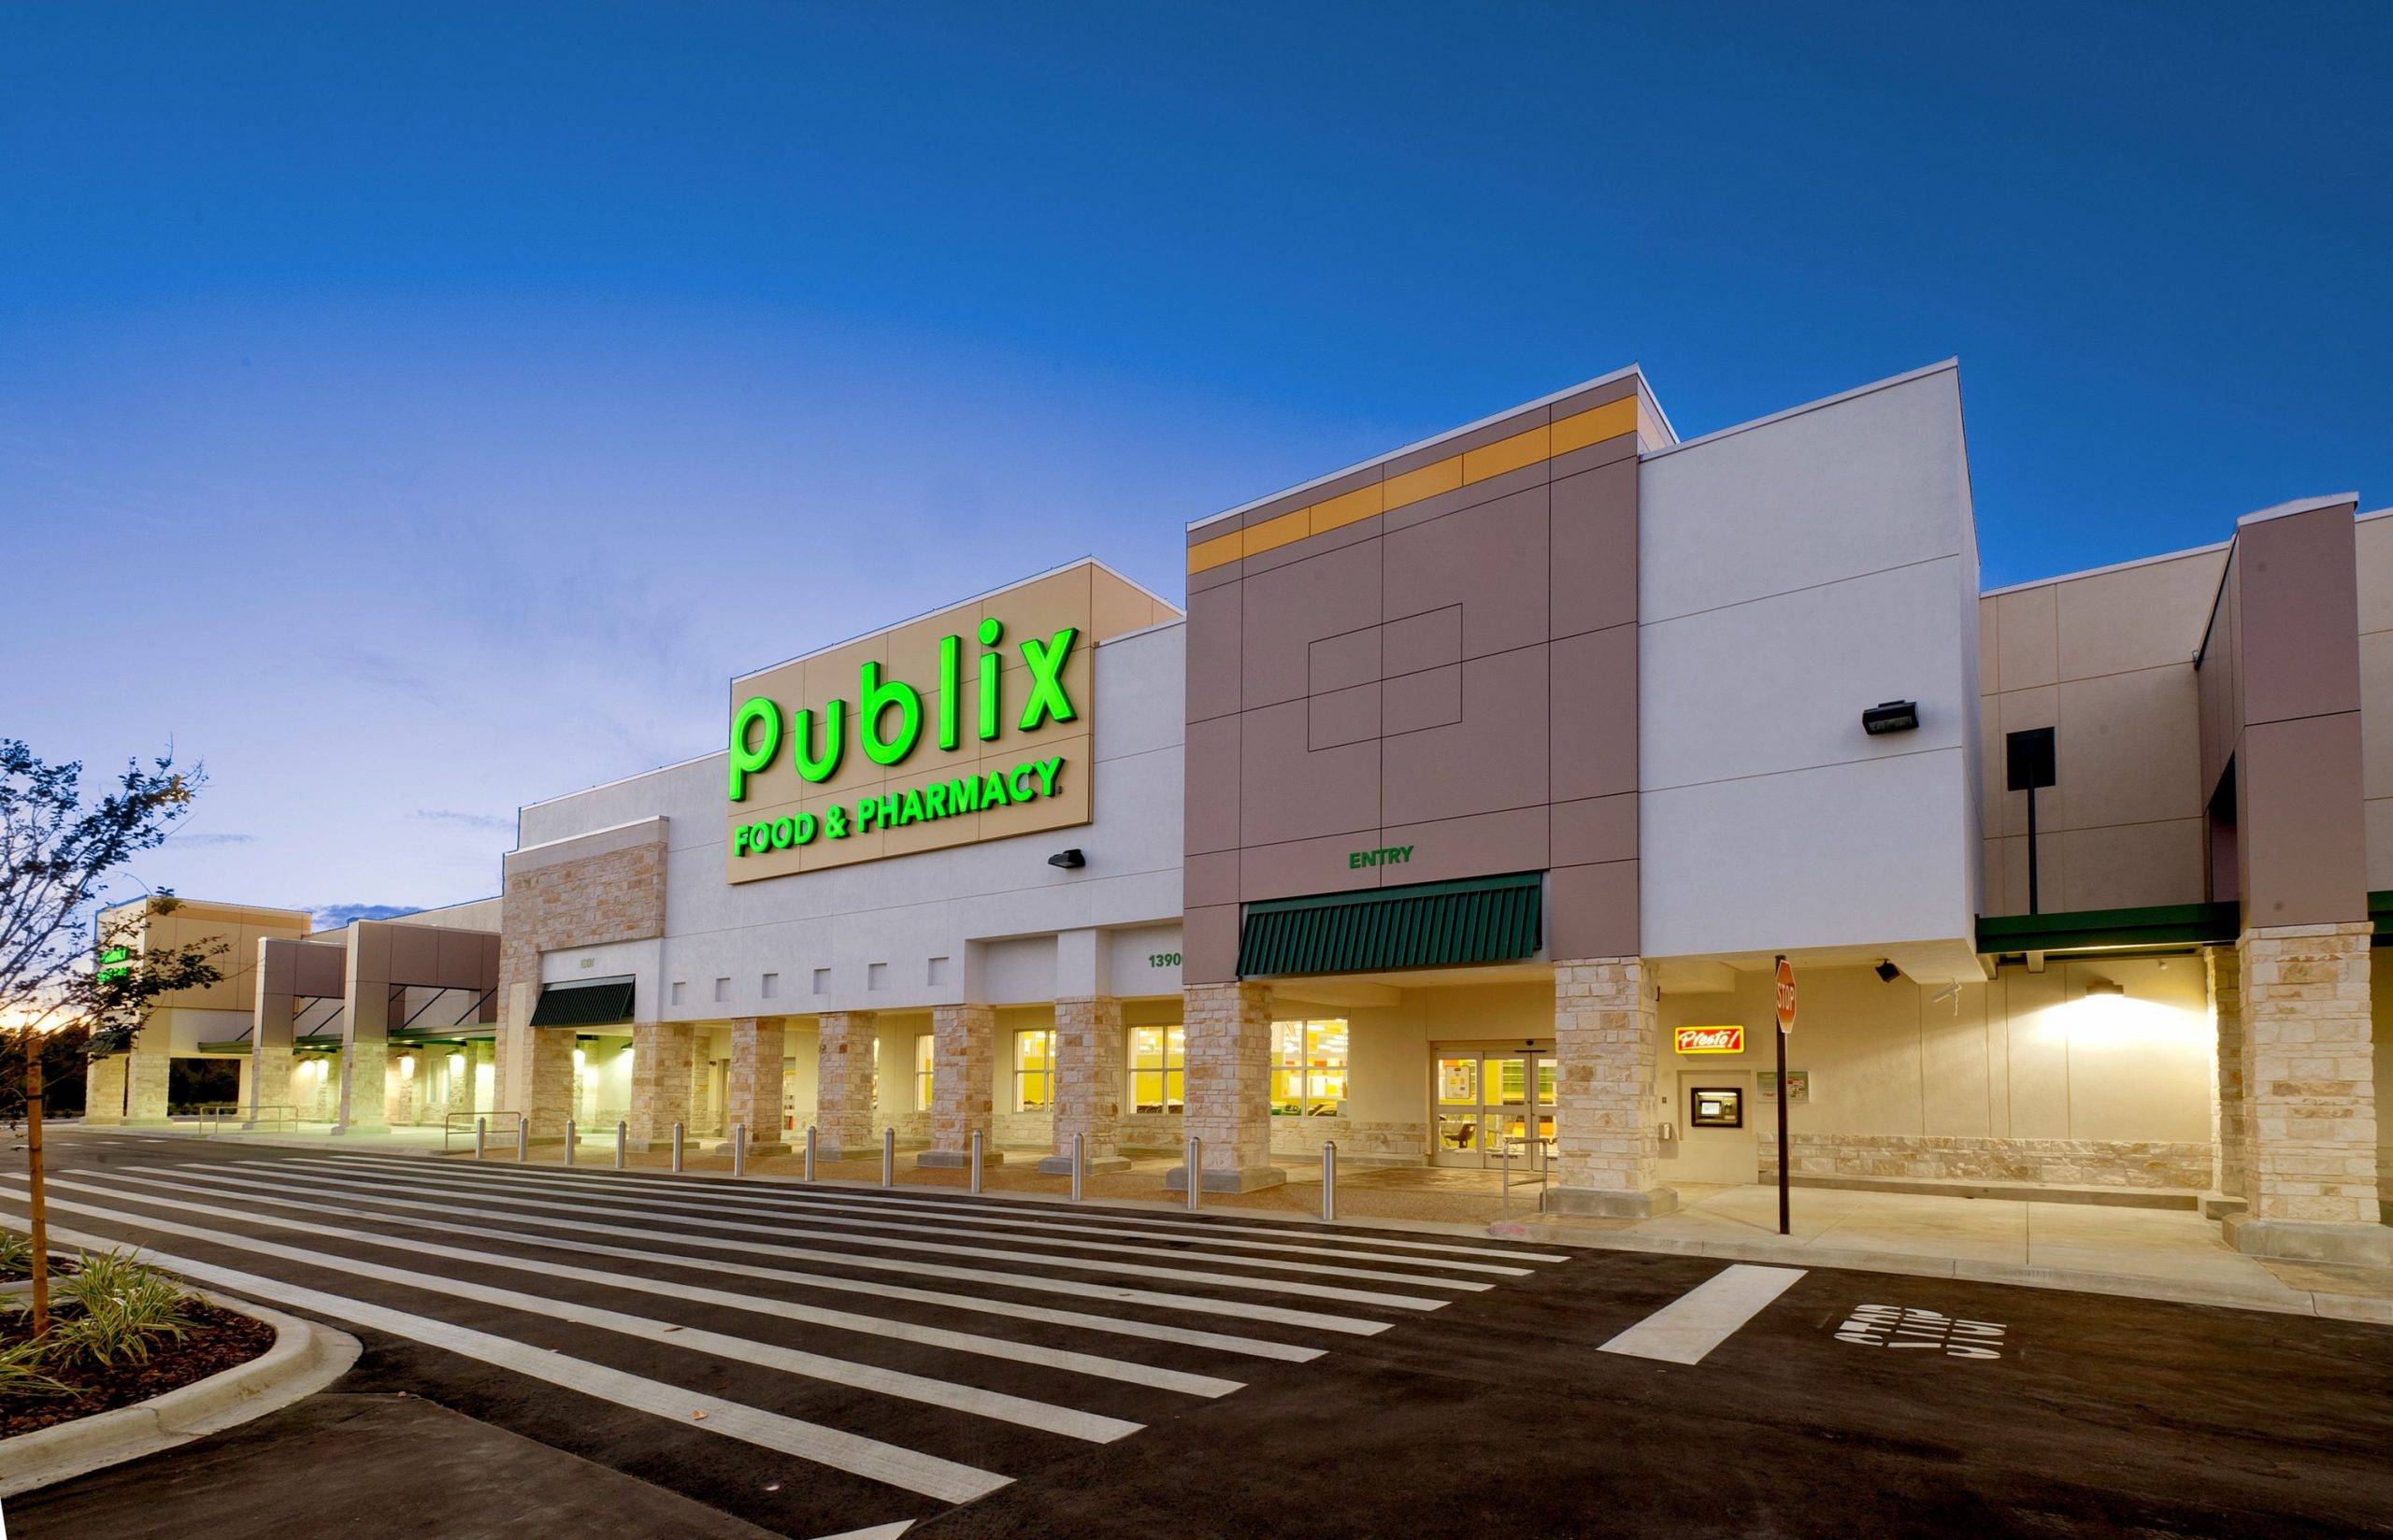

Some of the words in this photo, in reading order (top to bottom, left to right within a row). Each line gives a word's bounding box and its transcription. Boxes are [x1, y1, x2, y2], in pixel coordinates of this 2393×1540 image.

[734, 811, 819, 858] FOOD
[824, 803, 851, 840] &
[857, 755, 1066, 834] PHARMACY
[1349, 845, 1414, 869] ENTRY
[1148, 952, 1182, 968] 1390
[1777, 982, 1795, 1011] STOP
[1678, 1030, 1741, 1049] Presto!
[1833, 1304, 2007, 1360] STOP
